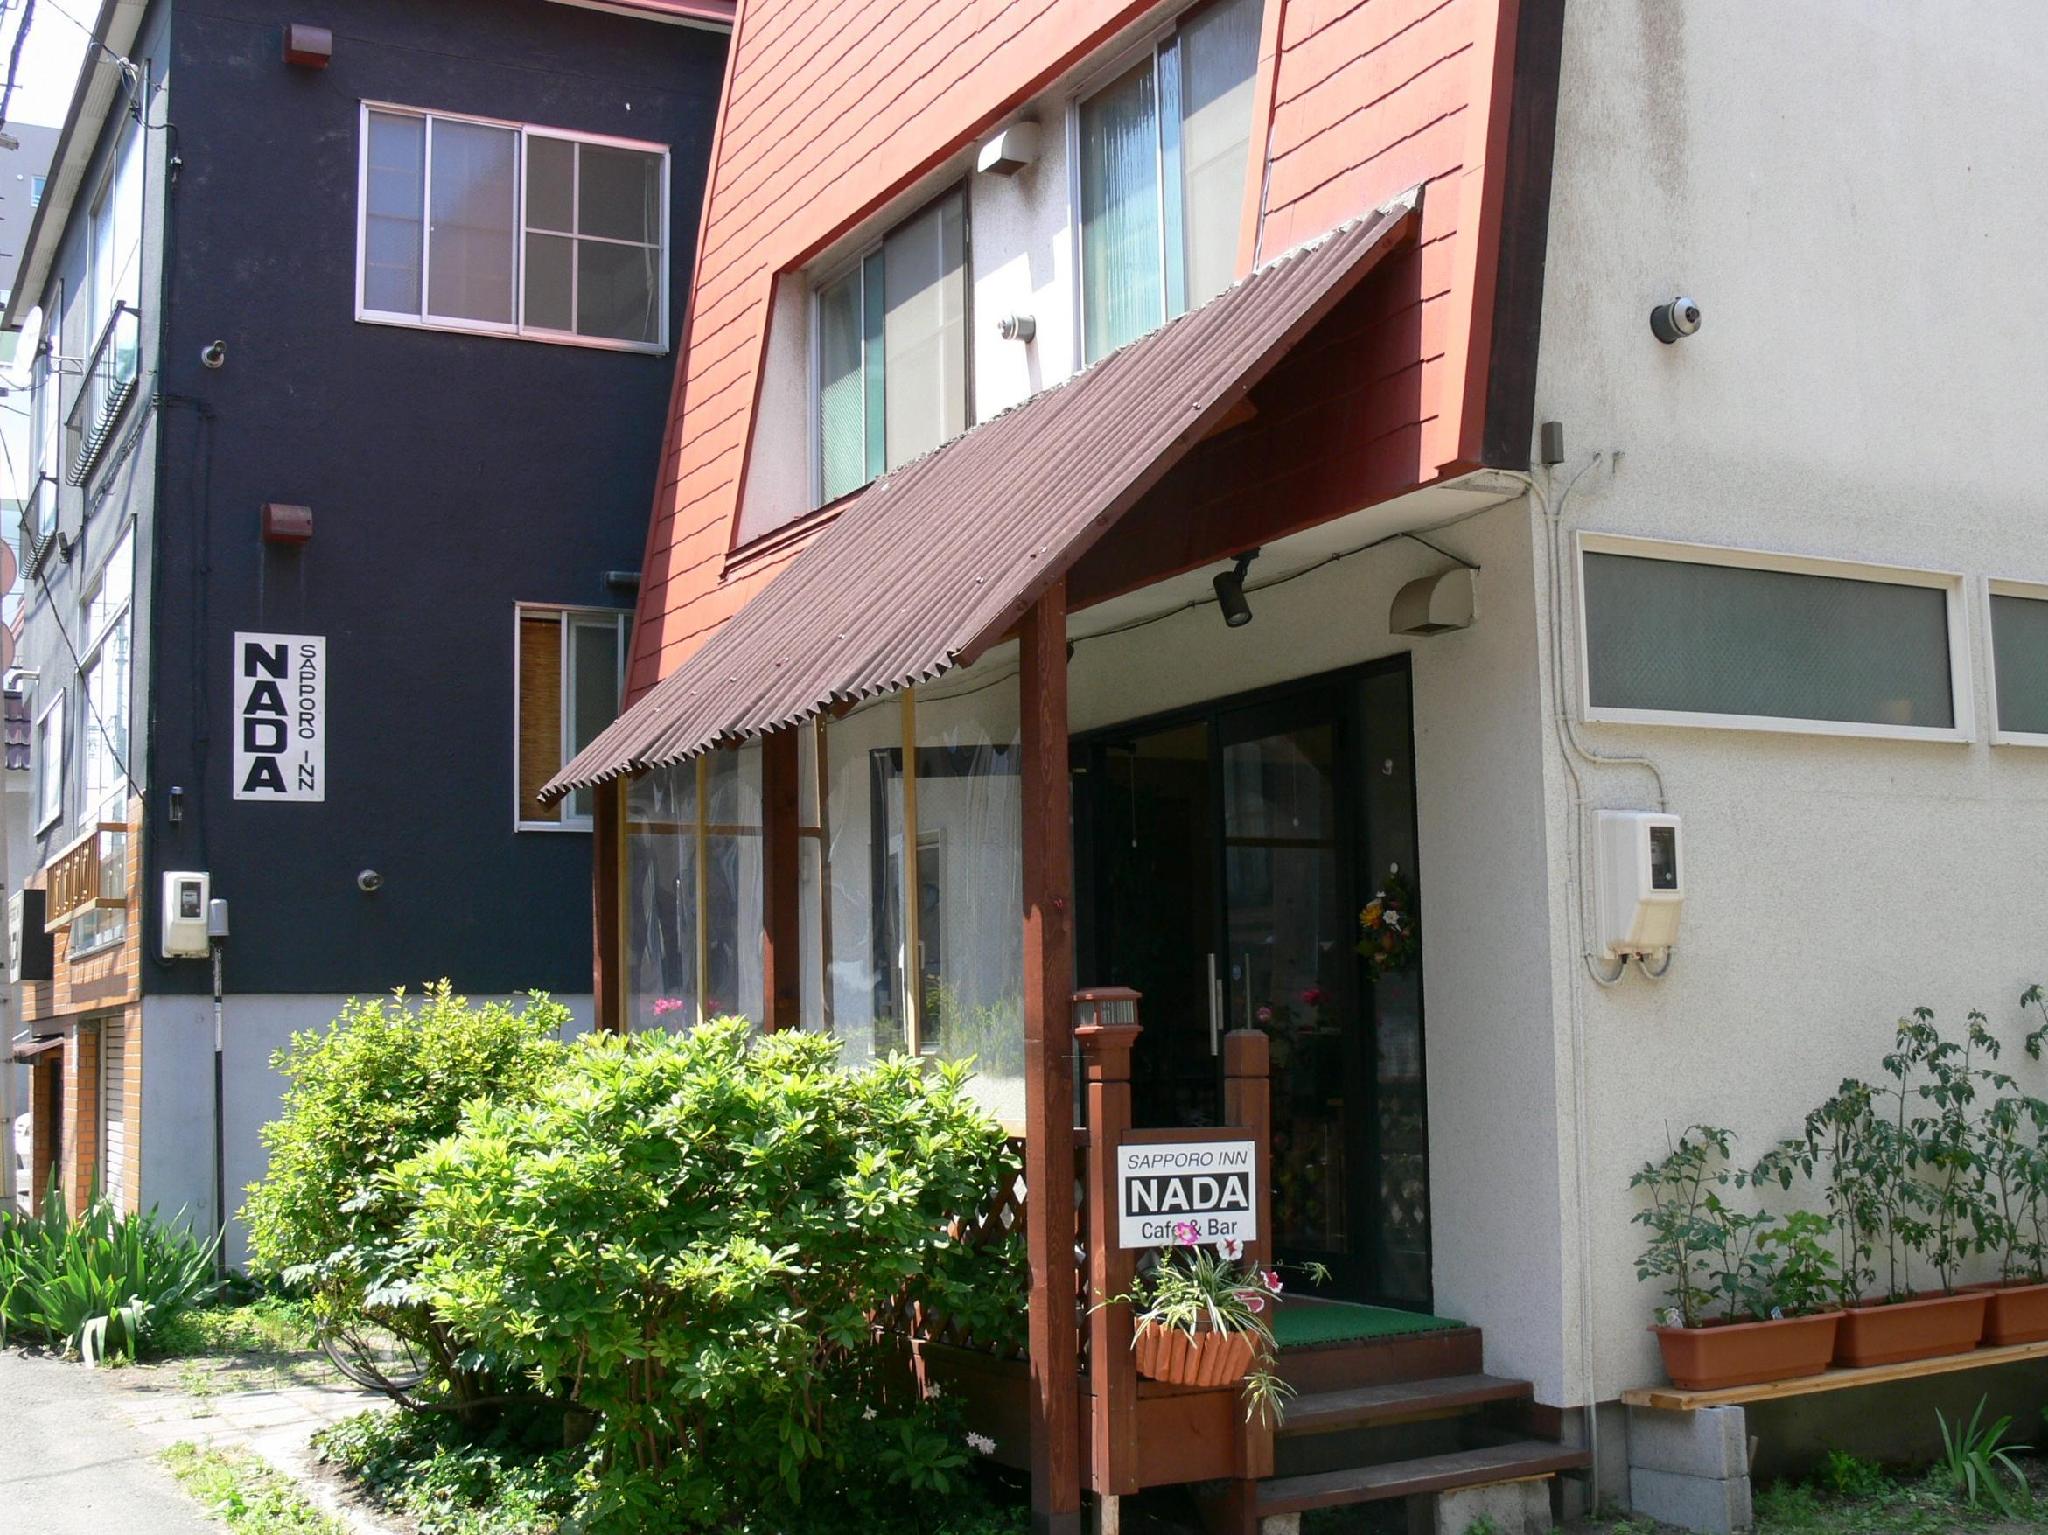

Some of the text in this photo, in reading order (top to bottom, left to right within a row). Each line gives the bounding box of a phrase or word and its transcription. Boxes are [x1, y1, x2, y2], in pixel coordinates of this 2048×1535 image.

[242, 642, 289, 793] NADA
[298, 644, 317, 791] SAPPORO INN
[1127, 1150, 1249, 1170] SAPPORO INN
[1131, 1175, 1249, 1213] NADA
[1207, 1218, 1238, 1236] Bar
